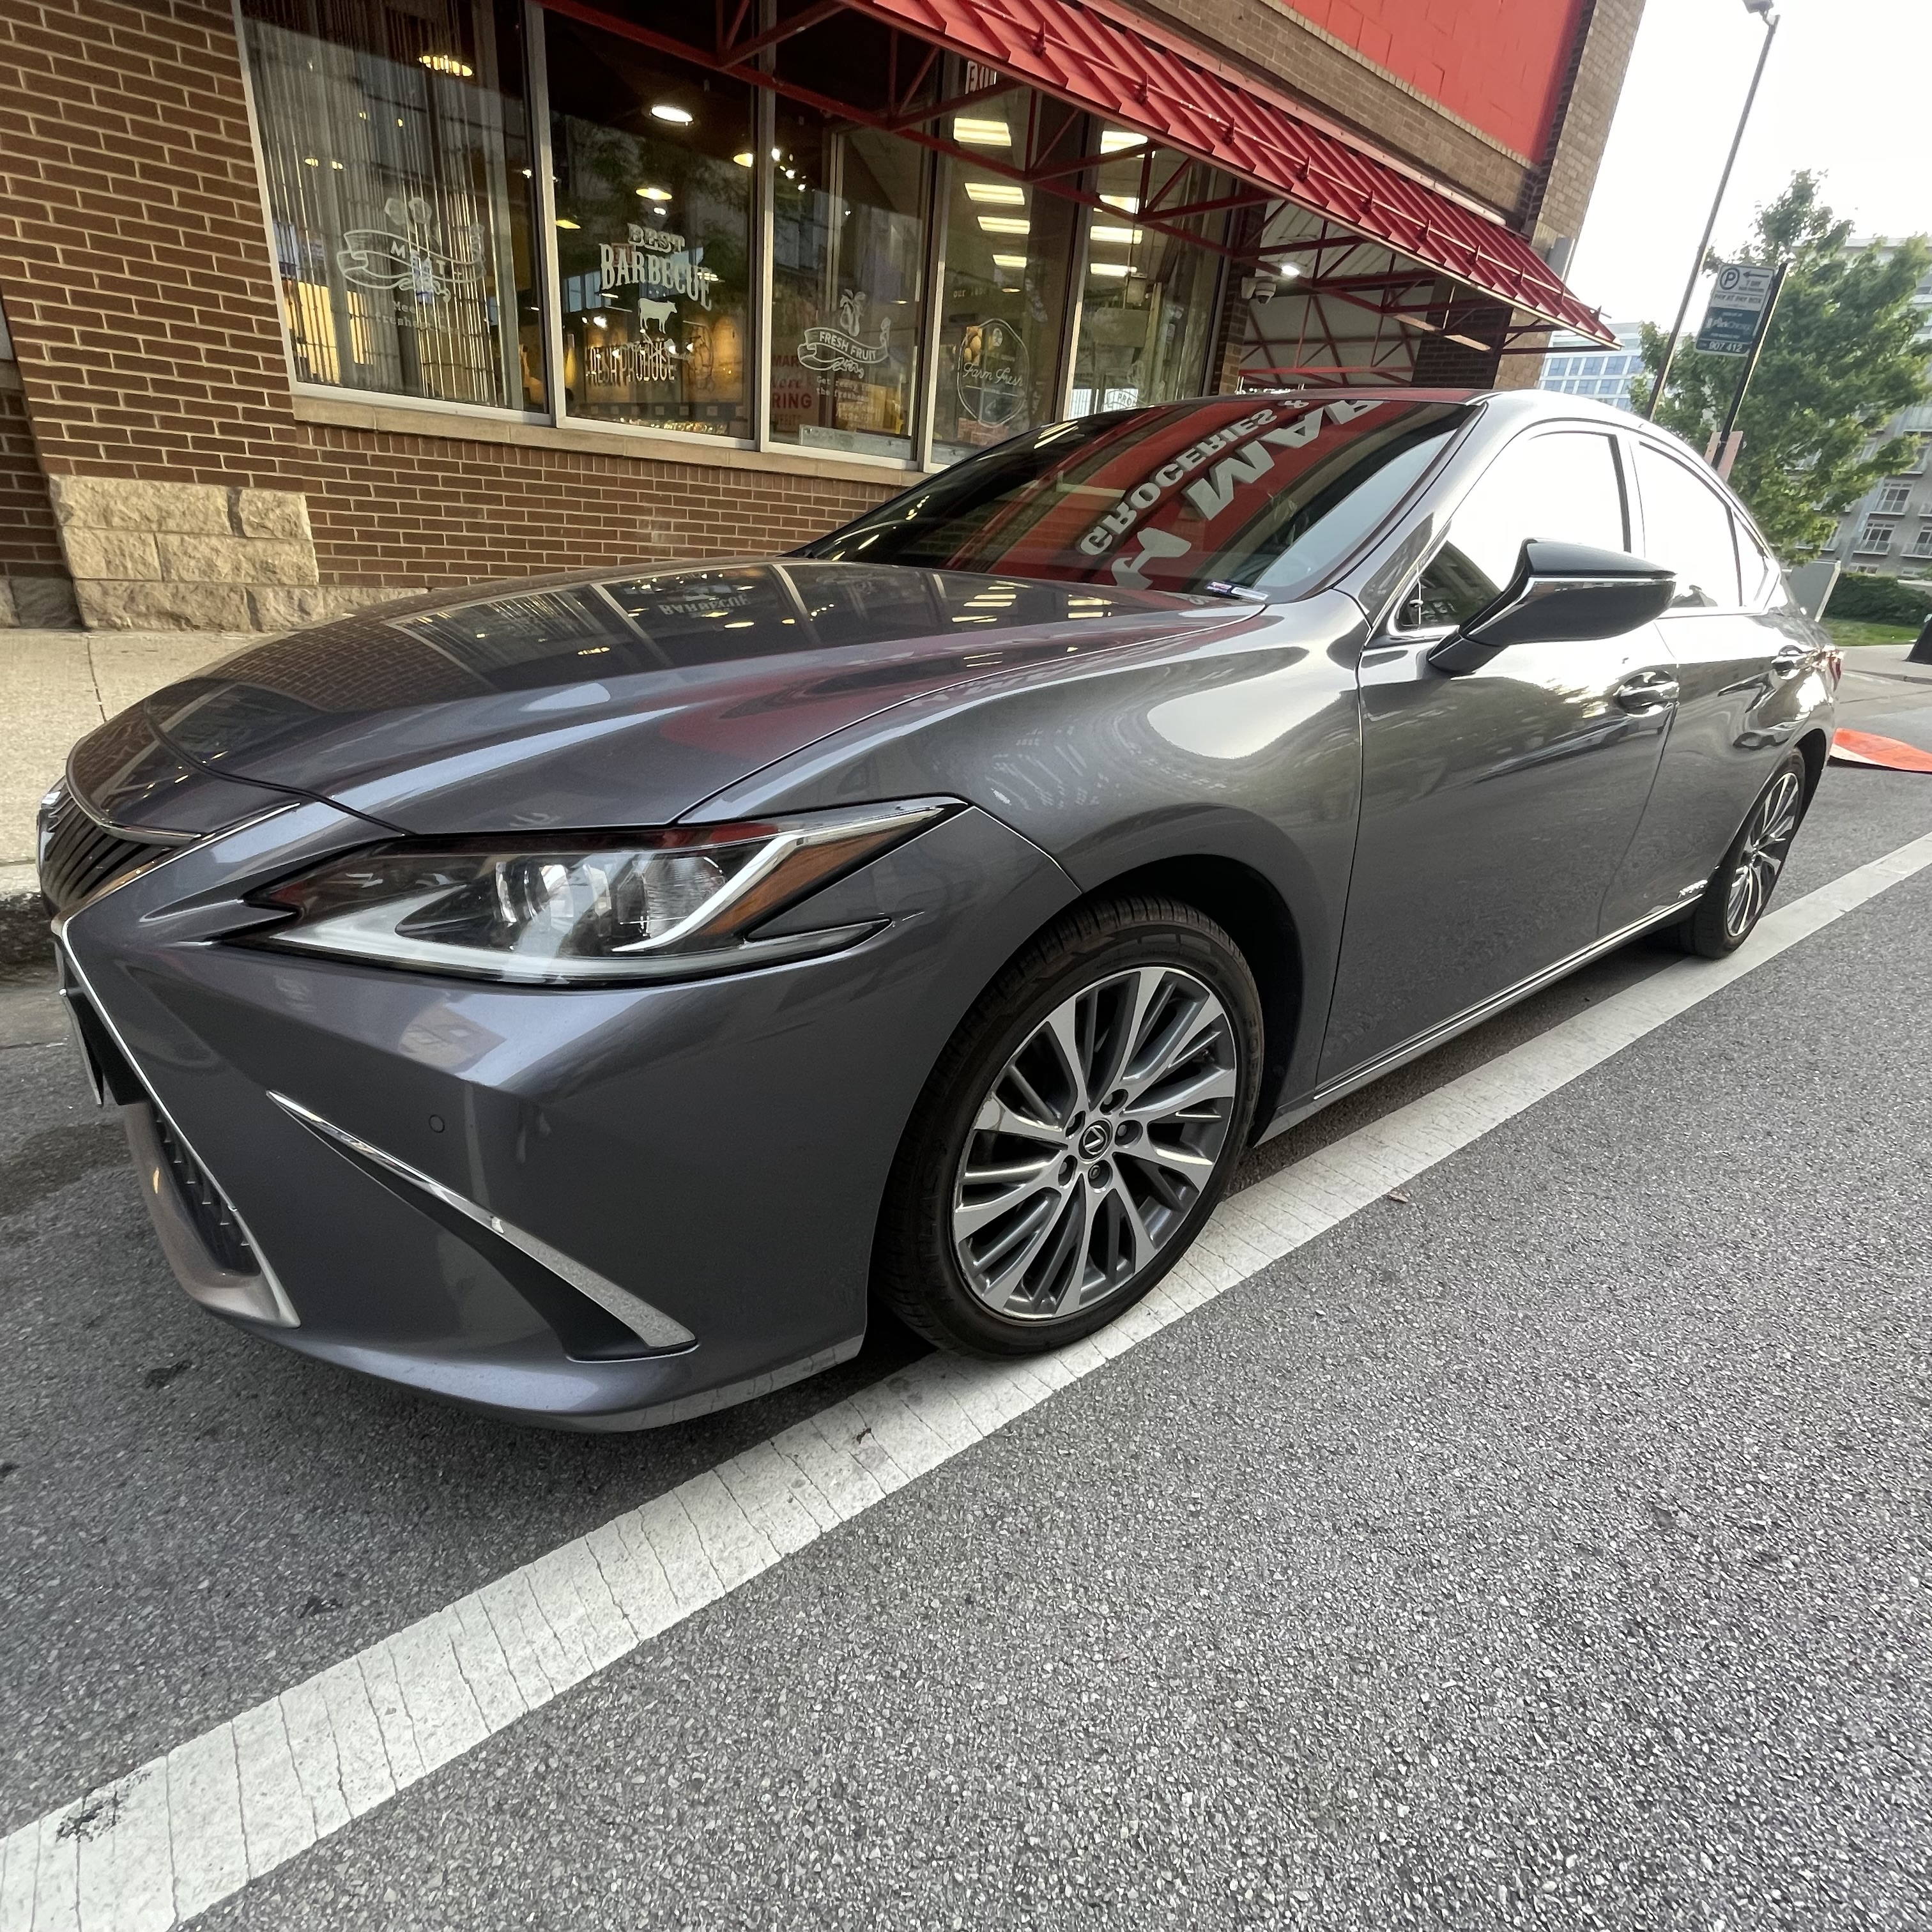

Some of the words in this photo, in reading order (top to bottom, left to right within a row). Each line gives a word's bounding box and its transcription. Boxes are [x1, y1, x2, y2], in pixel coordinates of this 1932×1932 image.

[627, 223, 686, 254] BEST
[599, 243, 712, 311] BARBECUE
[819, 331, 848, 351] FRESH
[850, 345, 877, 361] FRUIT
[1726, 342, 1743, 352] 412
[962, 362, 993, 381] Farm
[995, 367, 1023, 387] Fresh
[816, 387, 831, 395] the
